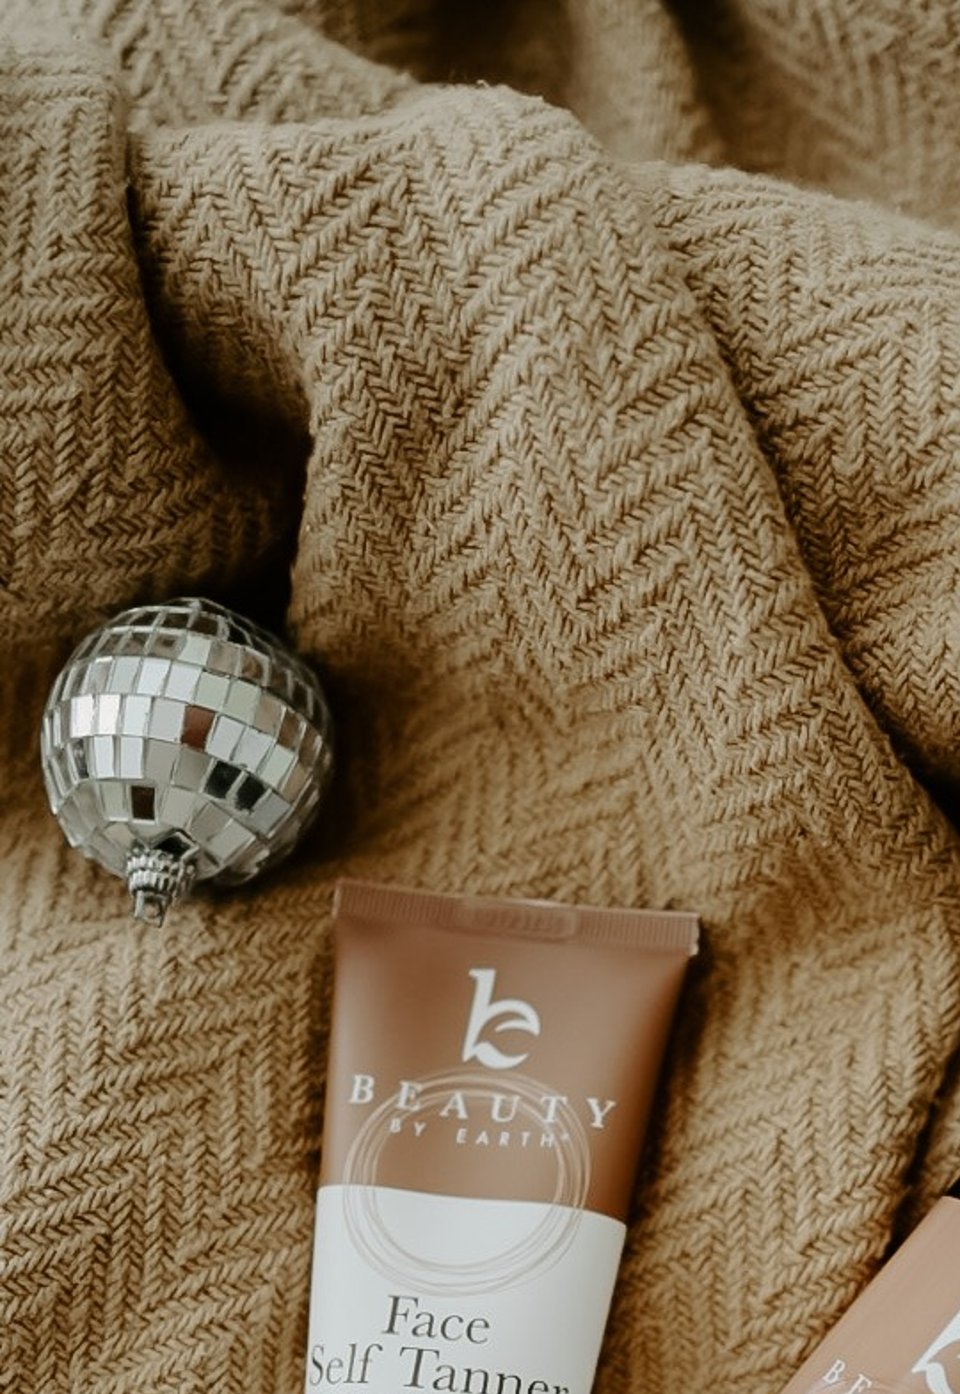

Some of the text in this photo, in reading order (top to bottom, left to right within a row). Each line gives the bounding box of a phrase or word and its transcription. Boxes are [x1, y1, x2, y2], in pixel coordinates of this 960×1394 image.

[350, 1075, 616, 1128] BEAUTY
[389, 1119, 427, 1137] BY
[382, 1294, 490, 1344] Face
[309, 1343, 383, 1387] Self
